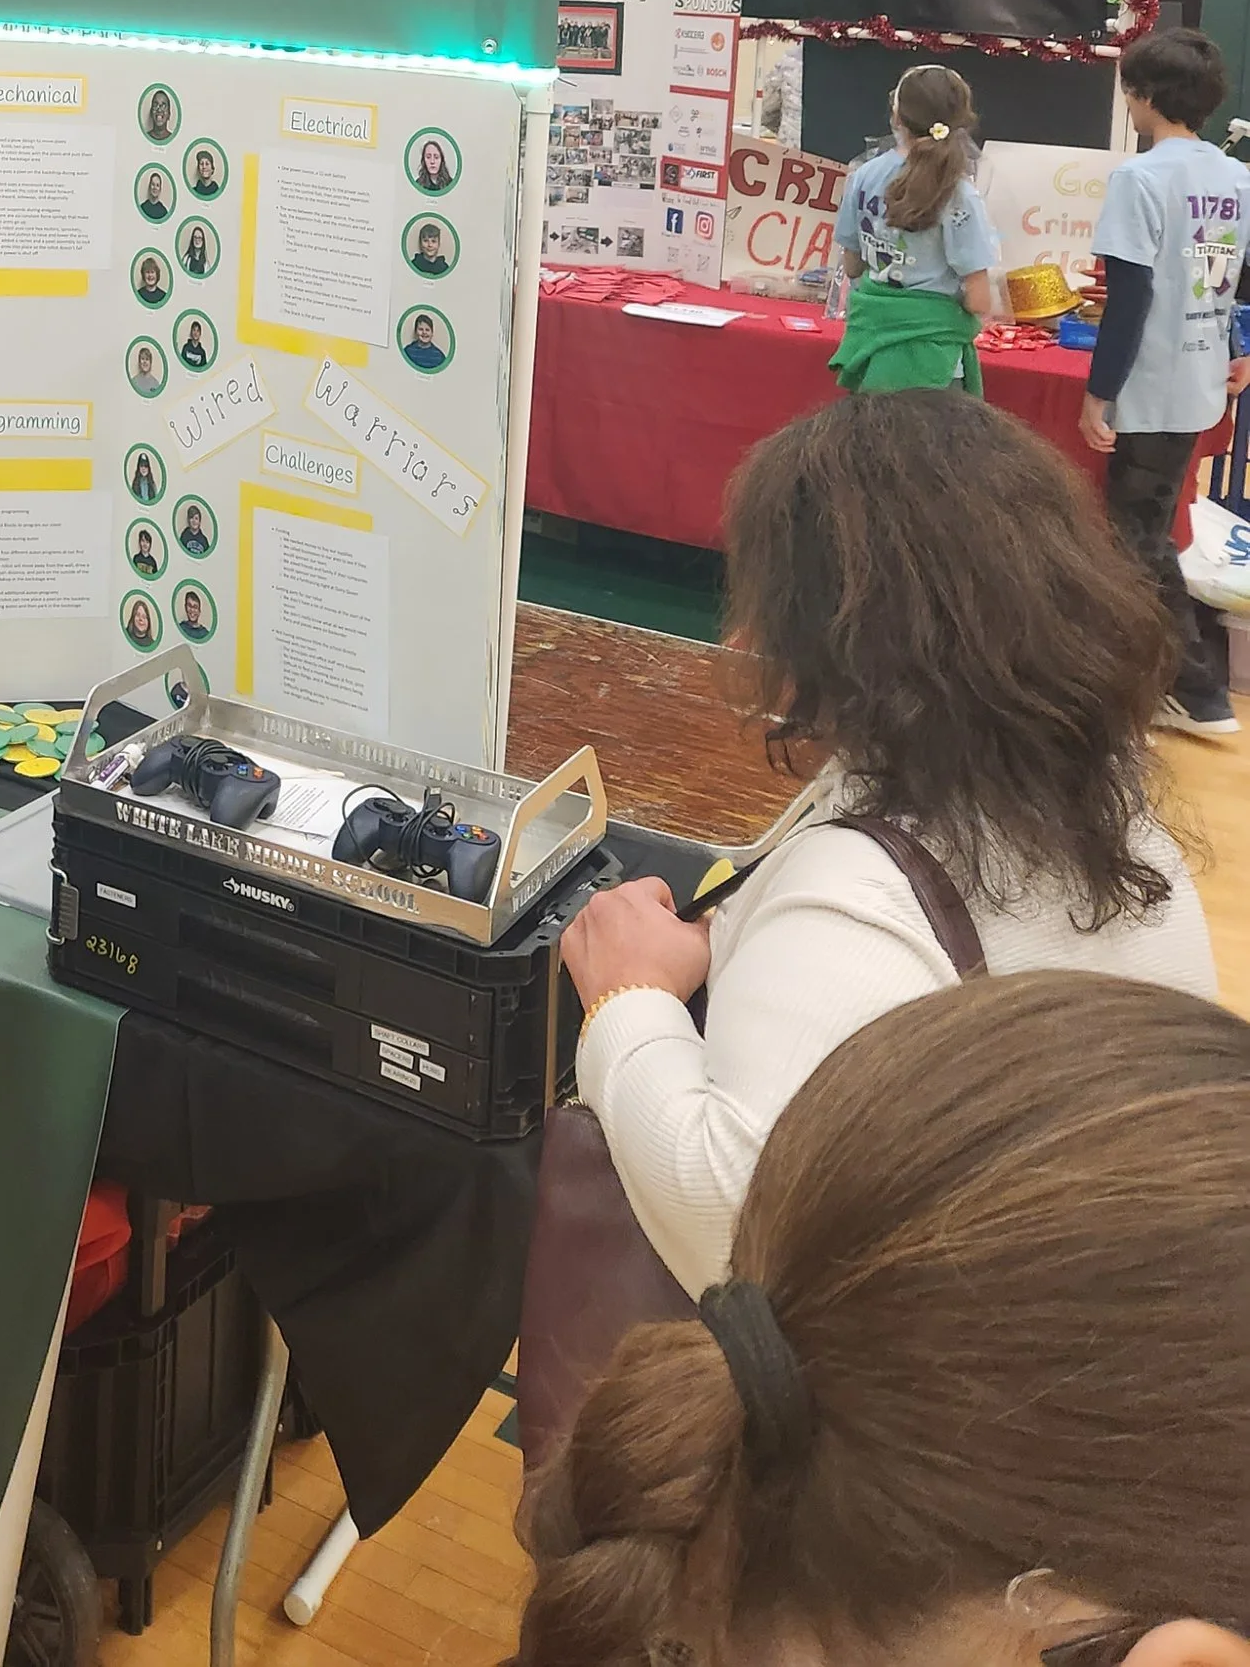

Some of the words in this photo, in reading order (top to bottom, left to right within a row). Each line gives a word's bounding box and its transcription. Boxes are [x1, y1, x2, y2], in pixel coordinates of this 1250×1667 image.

[290, 110, 369, 141] Electrical
[695, 170, 716, 180] FIRST
[169, 362, 264, 451] Wired
[315, 359, 479, 517] Warriors
[265, 443, 354, 486] Challenges
[116, 801, 182, 839] WHITE
[185, 823, 240, 857] LAKE
[244, 841, 326, 884] MIDDLE
[331, 869, 420, 915] SCHOOL
[239, 884, 290, 911] HUSKY
[86, 935, 140, 974] 23168
